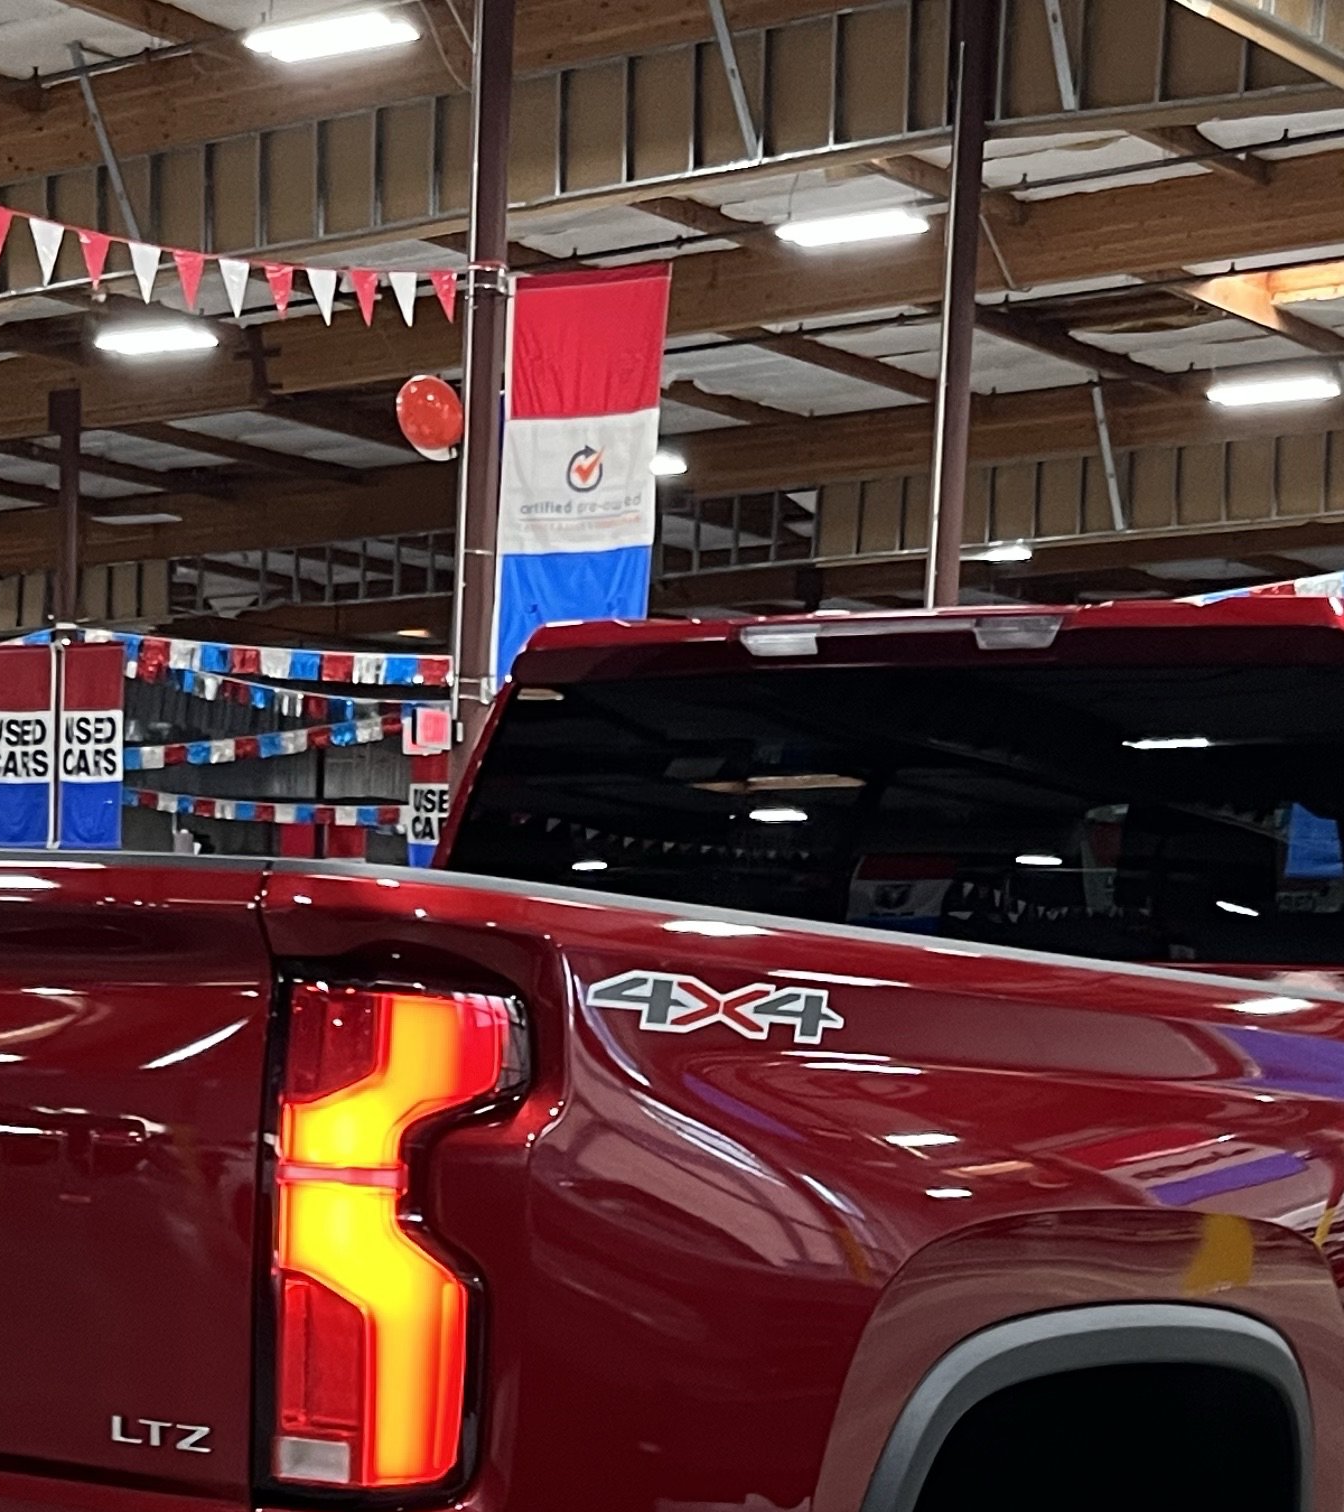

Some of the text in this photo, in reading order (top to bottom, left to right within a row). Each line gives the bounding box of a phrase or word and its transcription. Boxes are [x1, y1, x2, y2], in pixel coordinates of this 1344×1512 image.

[65, 717, 116, 745] USED
[63, 747, 117, 776] CARS
[413, 788, 448, 813] USE
[112, 1415, 212, 1453] LTZ
